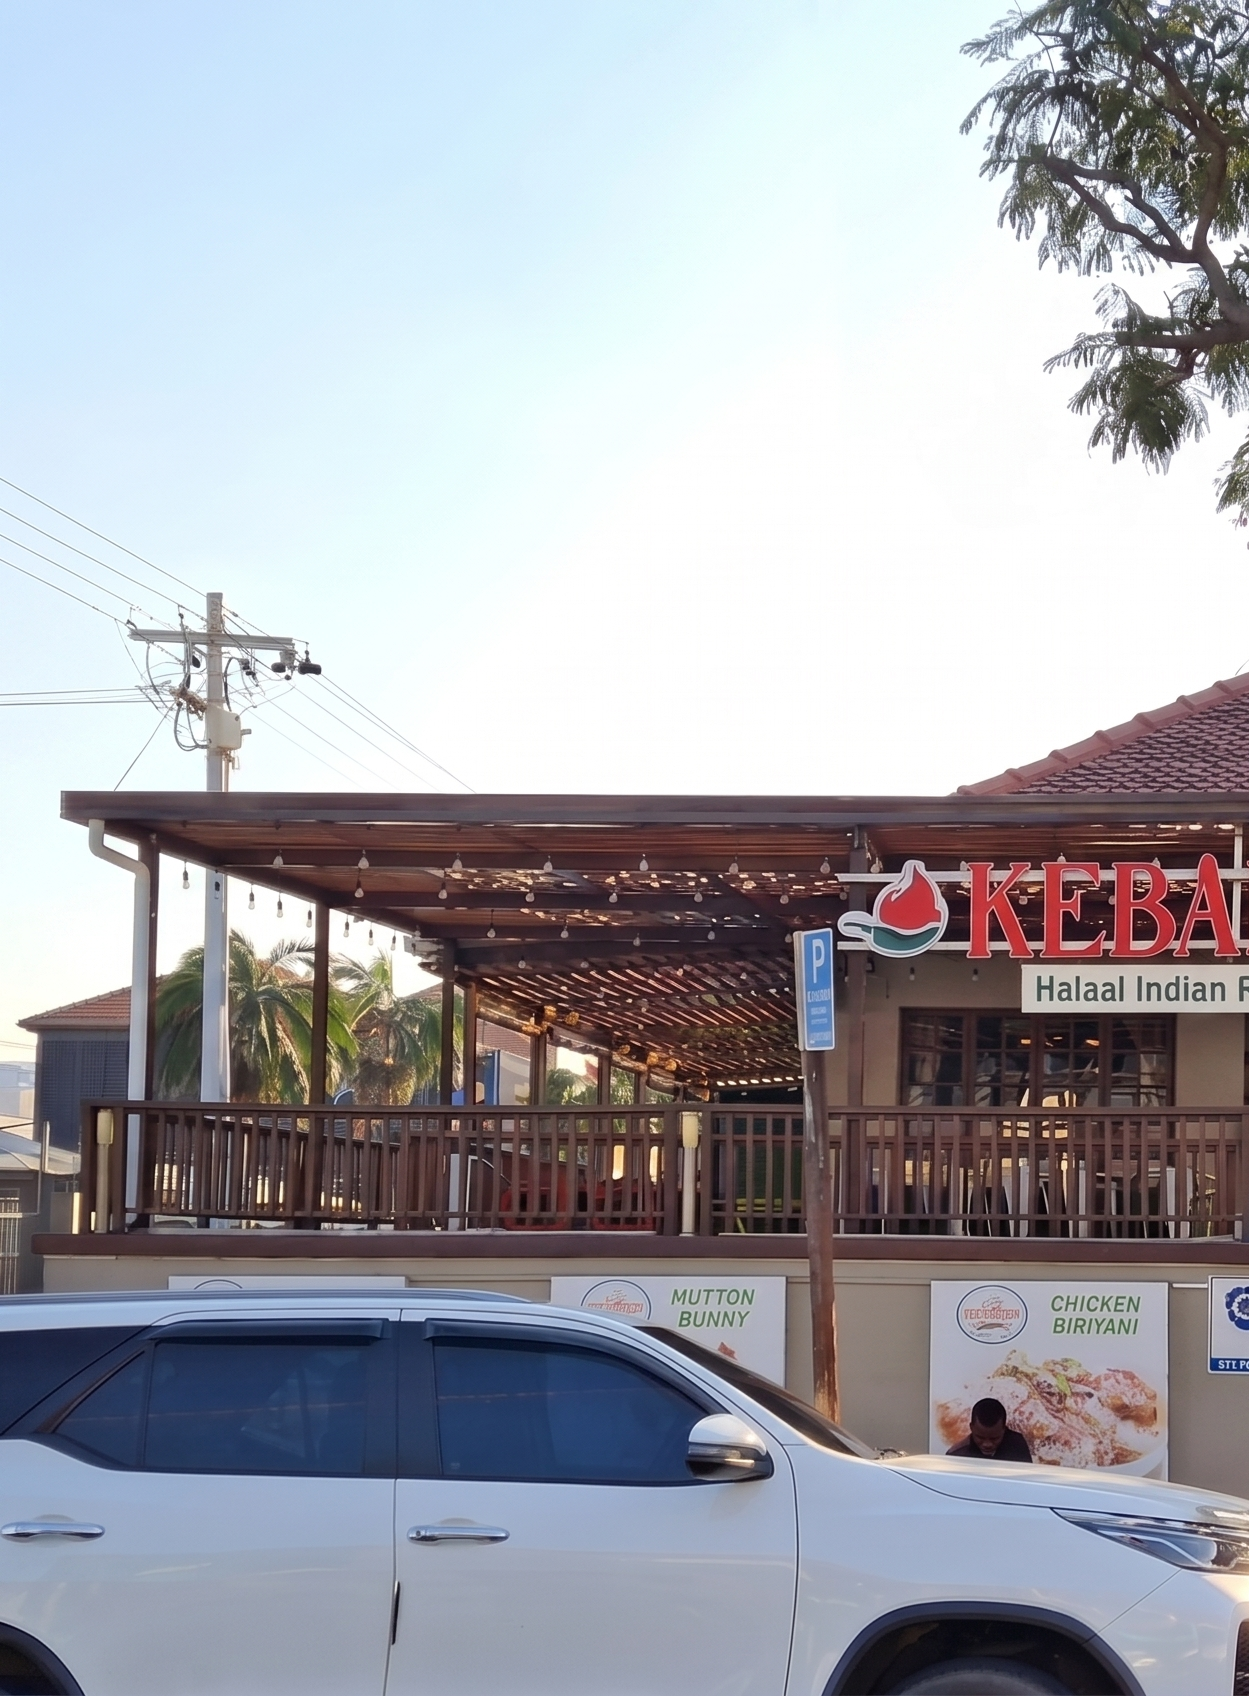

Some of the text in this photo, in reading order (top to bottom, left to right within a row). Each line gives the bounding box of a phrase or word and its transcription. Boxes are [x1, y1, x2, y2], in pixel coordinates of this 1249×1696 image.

[812, 938, 825, 984] P
[1036, 975, 1125, 1003] Halaal
[1136, 975, 1226, 1003] Indian
[671, 1288, 756, 1306] MUTTON
[1050, 1295, 1141, 1313] CHICKEN
[678, 1310, 751, 1328] BUNNY
[1052, 1317, 1139, 1335] BIRIYANI
